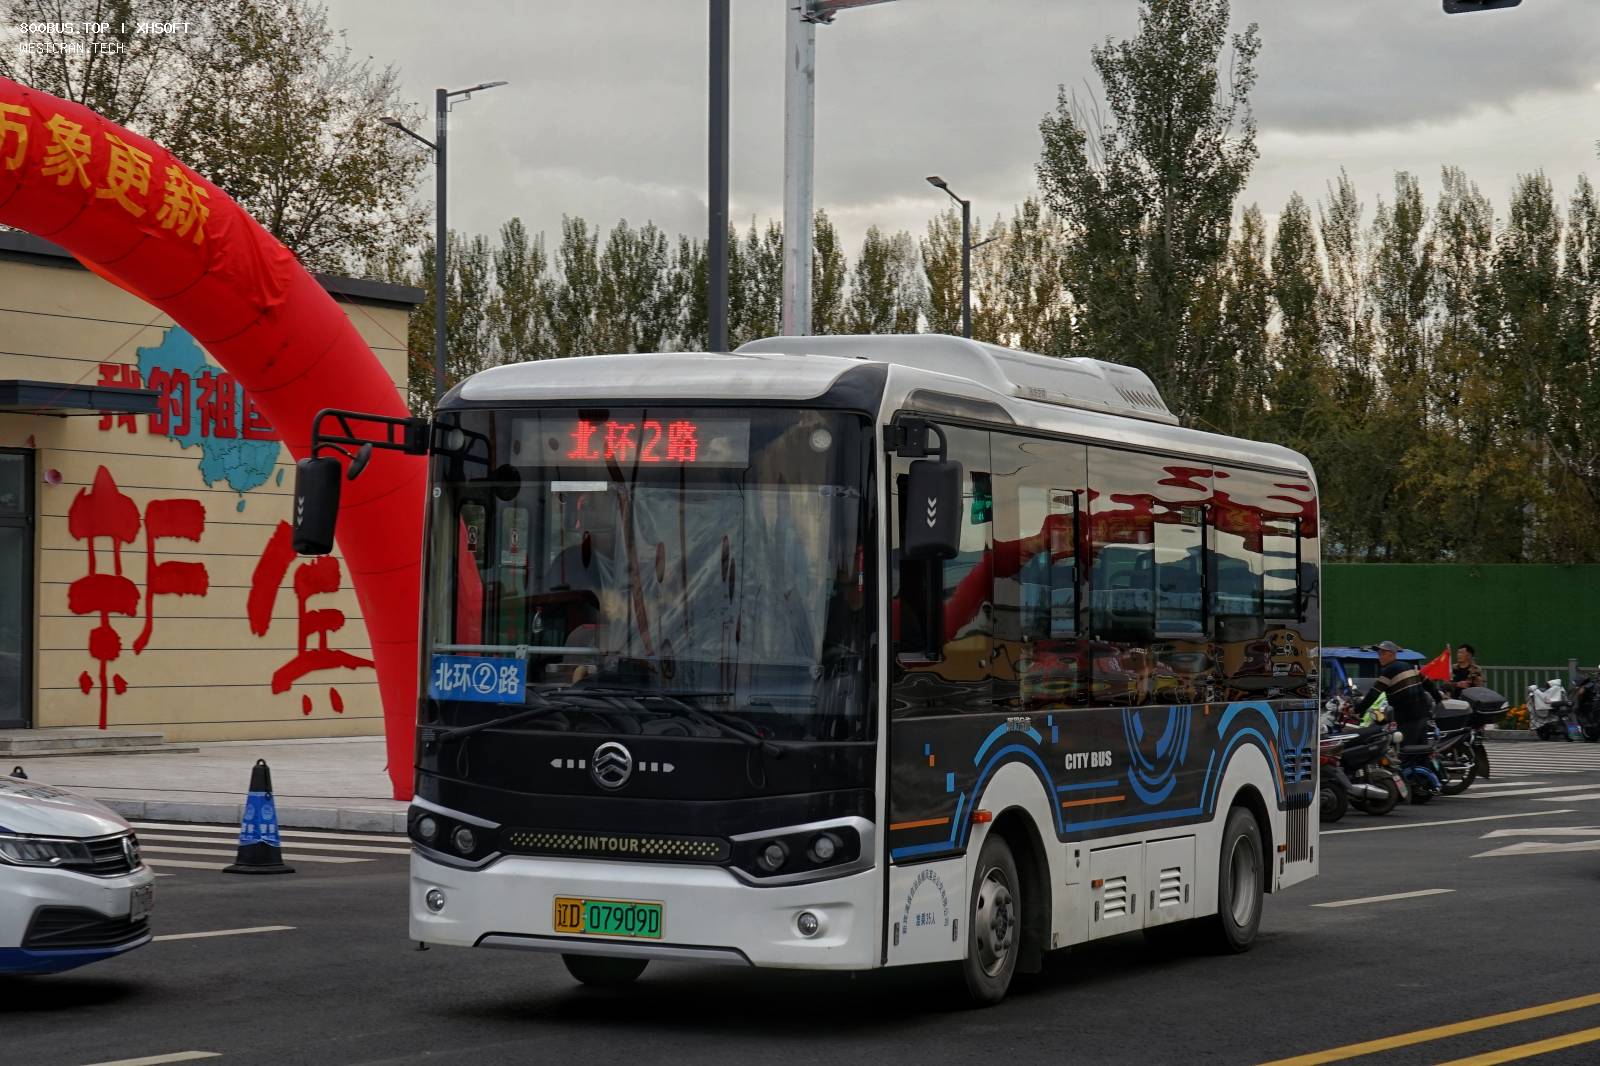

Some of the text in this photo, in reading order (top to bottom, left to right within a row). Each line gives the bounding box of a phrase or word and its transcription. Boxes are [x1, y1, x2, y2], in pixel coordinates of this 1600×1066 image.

[567, 418, 698, 462] 北环2路
[1064, 750, 1112, 770] CITY BUS
[584, 836, 639, 852] INTOUR
